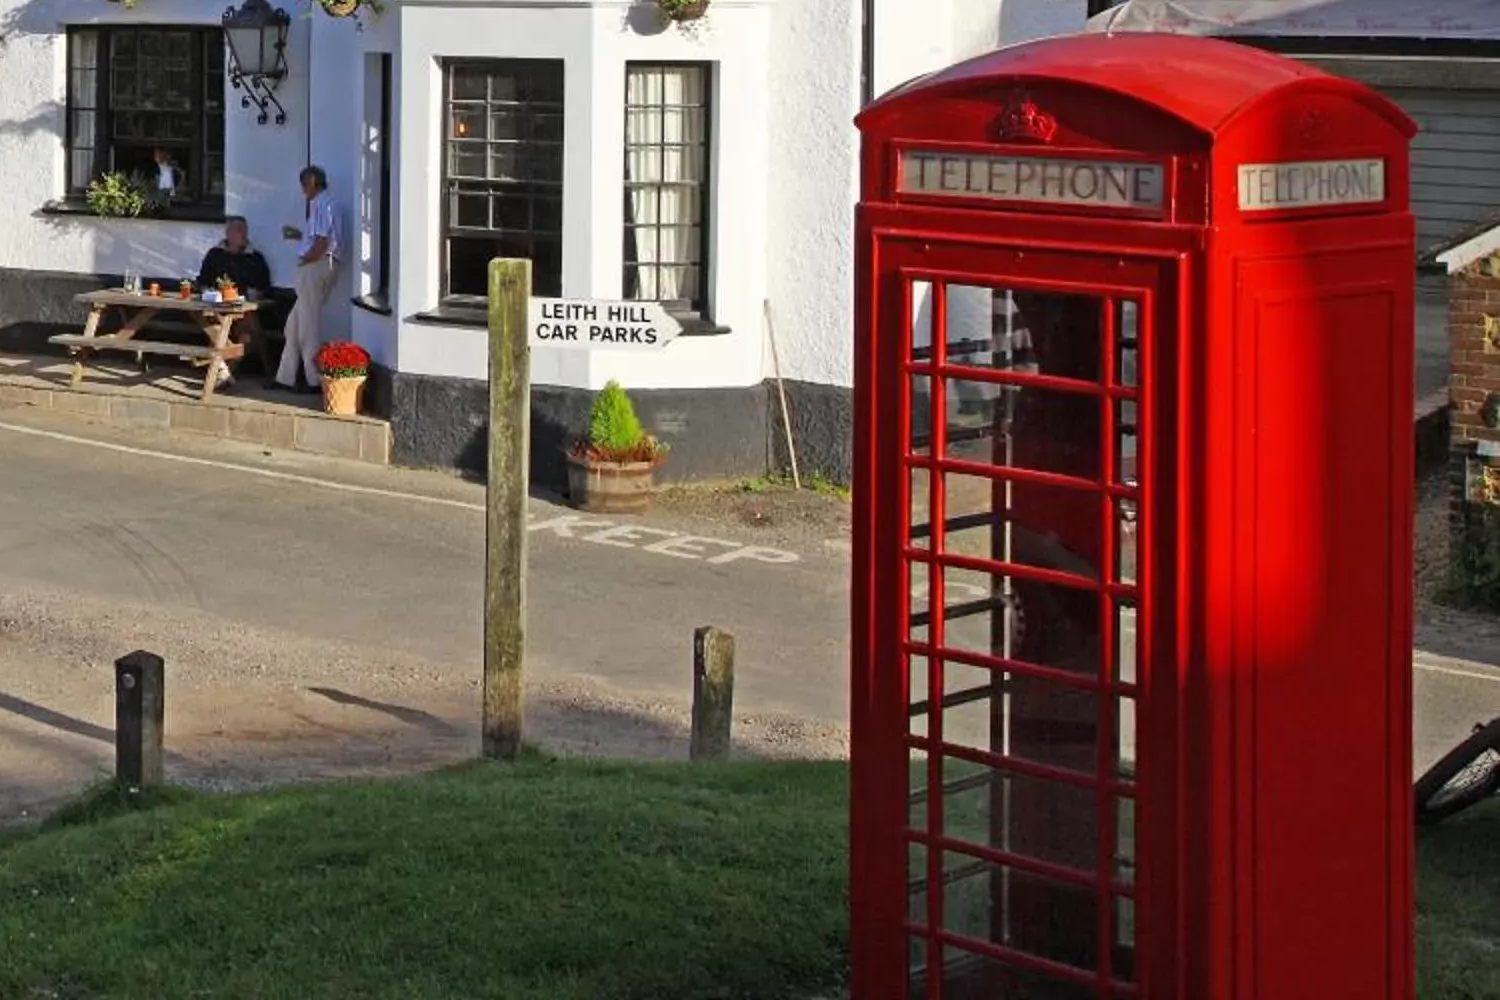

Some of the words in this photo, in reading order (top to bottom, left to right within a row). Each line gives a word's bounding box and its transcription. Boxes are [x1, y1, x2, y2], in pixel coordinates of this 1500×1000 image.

[910, 153, 1156, 203] TELEPHONE
[1240, 161, 1380, 206] TELEPHONE
[535, 323, 579, 341] CAR
[588, 325, 658, 344] PARKS
[541, 303, 597, 321] LEITH
[607, 305, 652, 323] HILL
[526, 514, 803, 565] KEEP
